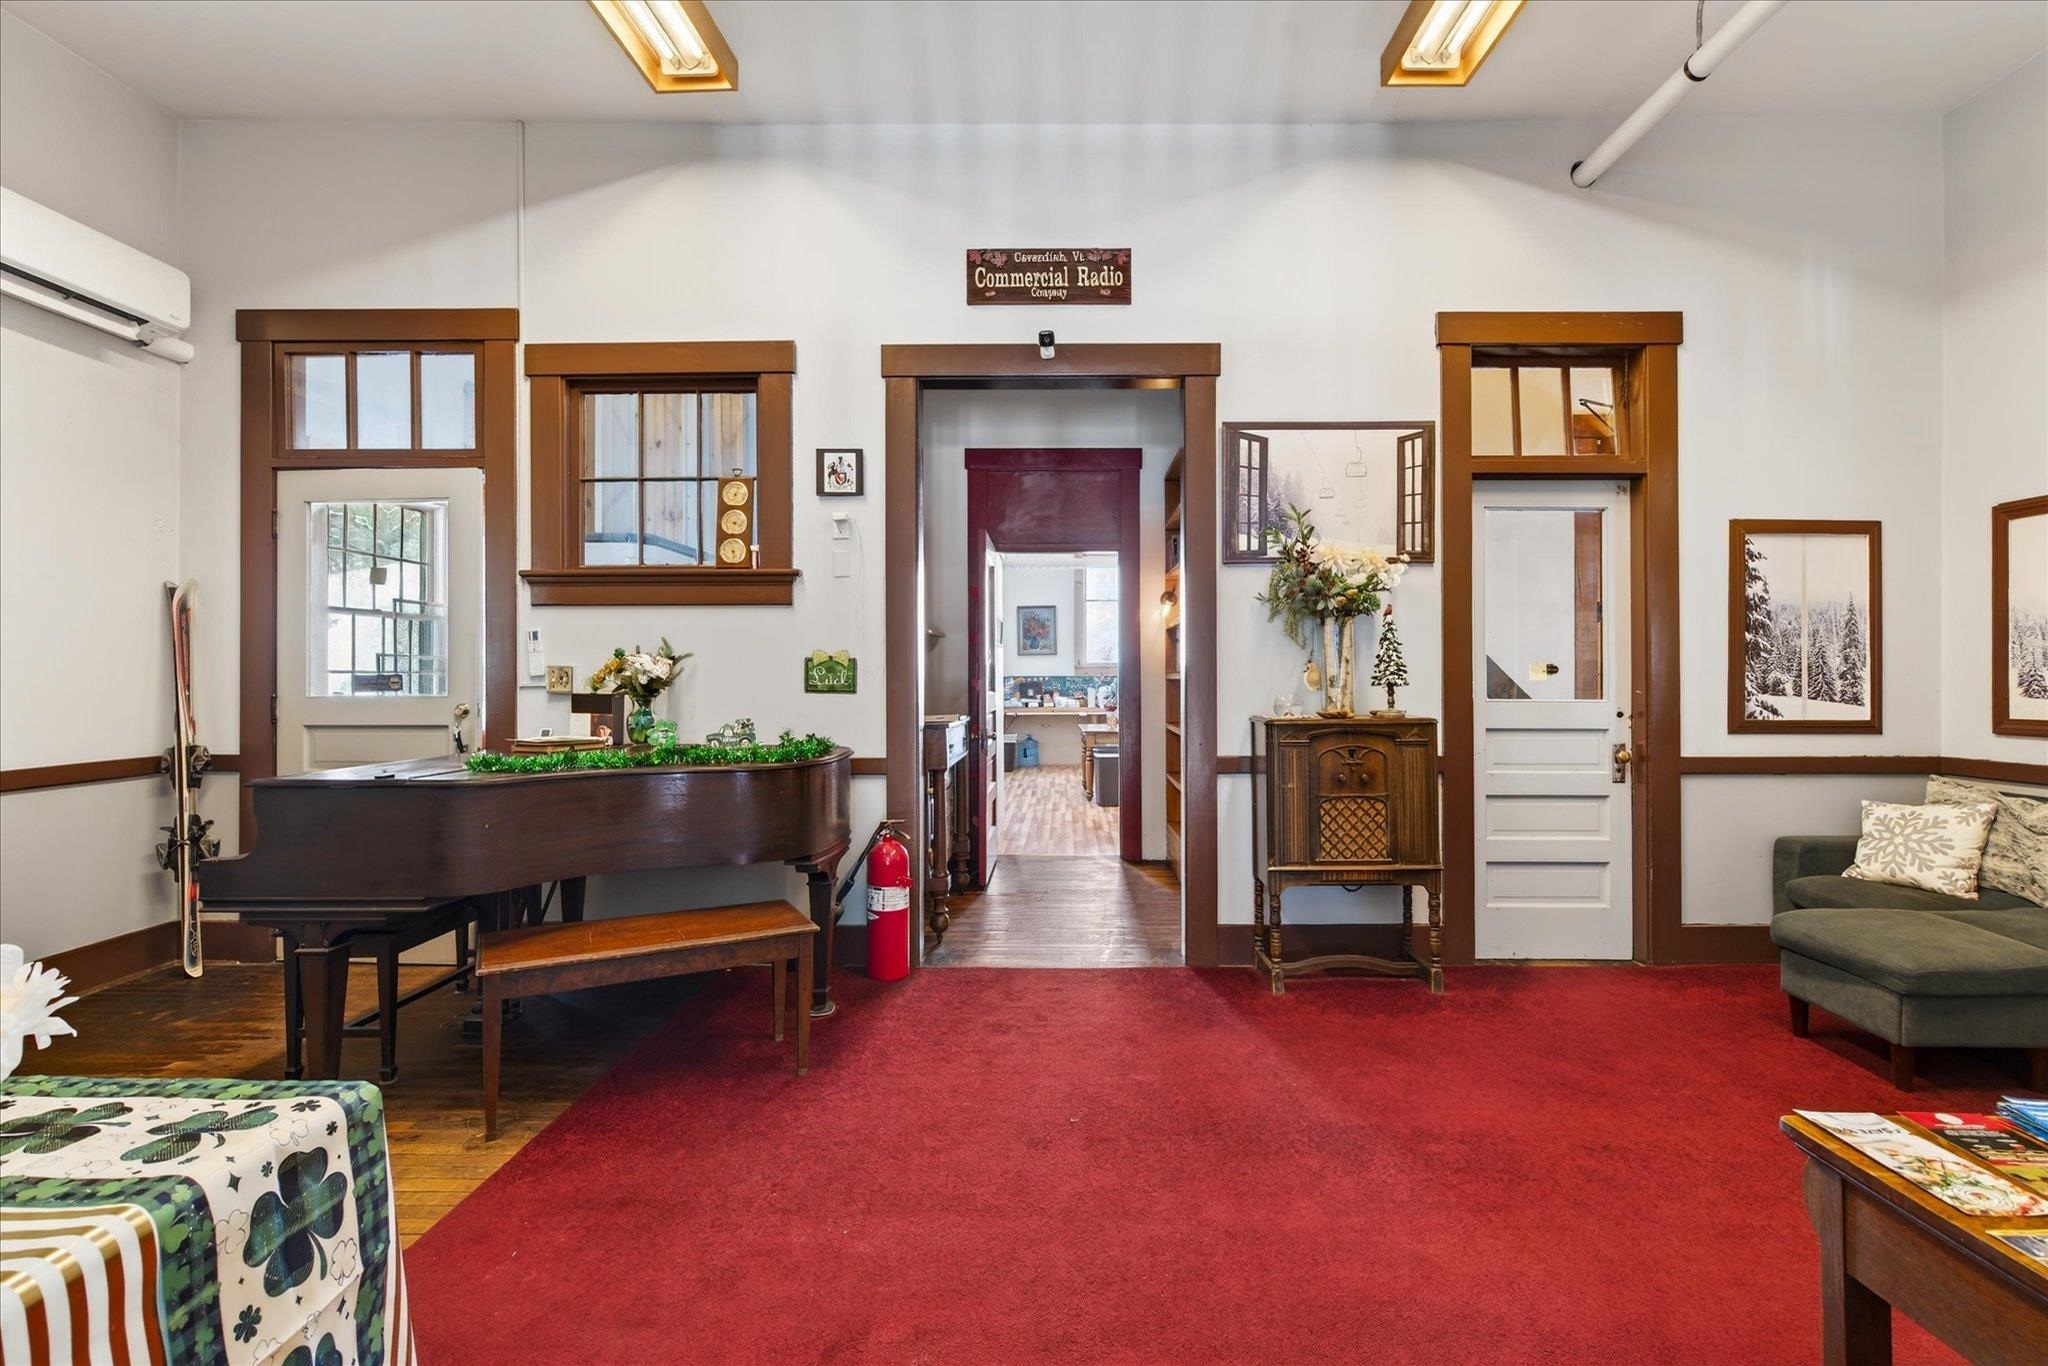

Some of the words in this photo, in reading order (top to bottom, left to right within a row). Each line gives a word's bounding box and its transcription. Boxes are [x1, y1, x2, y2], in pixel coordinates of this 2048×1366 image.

[974, 266, 1069, 288] Commercial
[1077, 265, 1123, 287] Radio
[1031, 287, 1068, 300] Company
